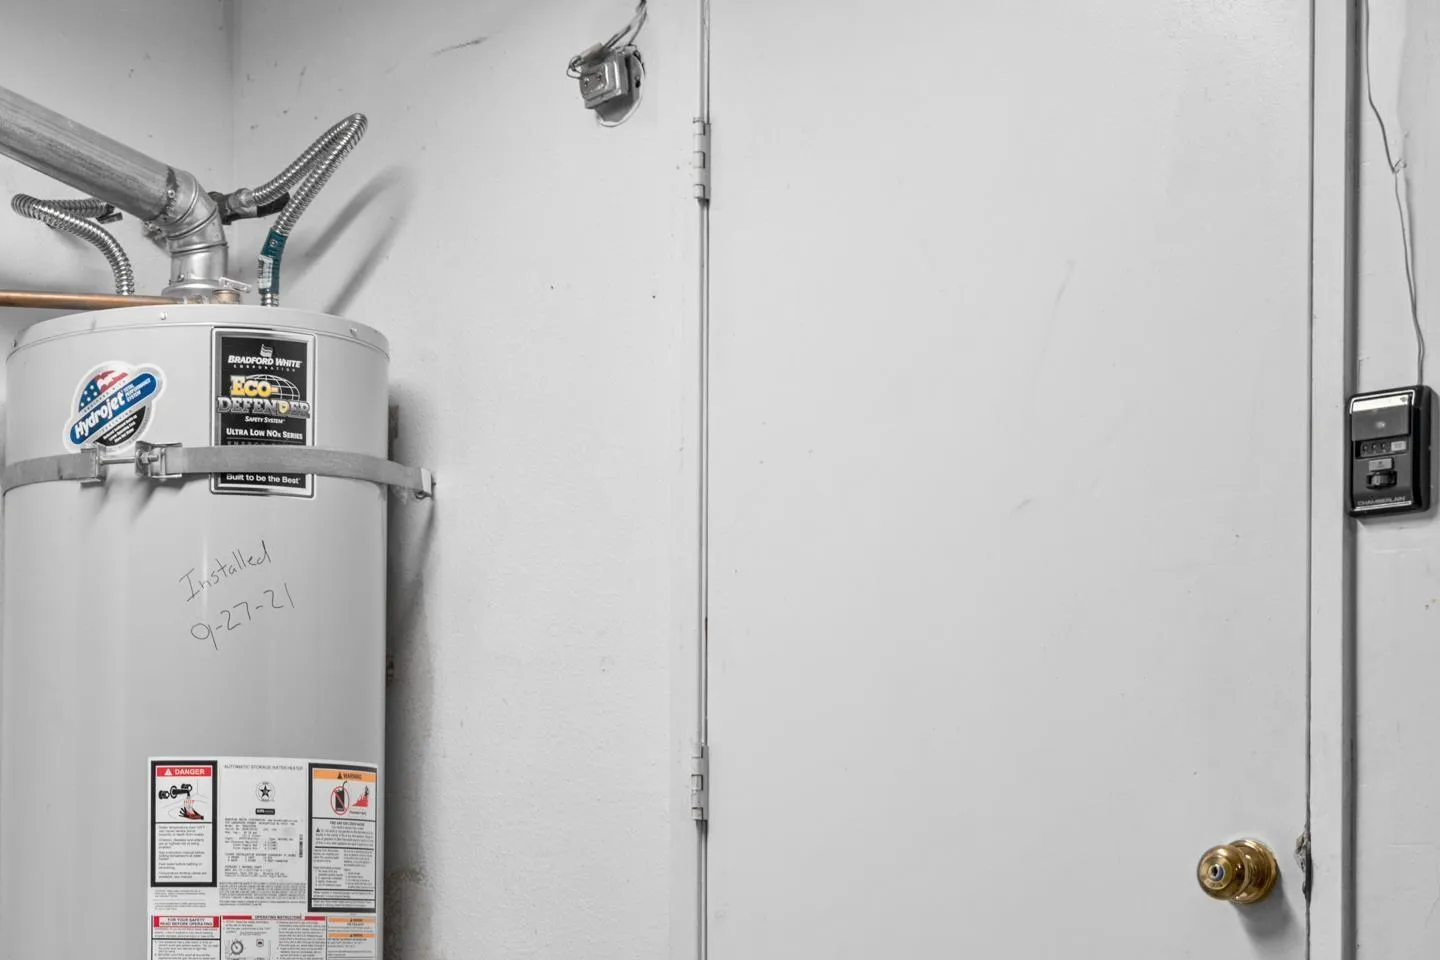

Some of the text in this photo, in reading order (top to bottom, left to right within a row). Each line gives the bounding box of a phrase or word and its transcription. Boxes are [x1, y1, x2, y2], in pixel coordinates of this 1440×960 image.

[227, 355, 303, 368] BRADFORD WHITE
[74, 390, 126, 439] Hydrojet
[217, 396, 311, 419] DEFENDER
[226, 428, 249, 436] ULTRA
[250, 429, 265, 437] LOW
[282, 431, 303, 440] SERIES
[226, 473, 245, 481] Built
[256, 474, 266, 482] be
[268, 475, 280, 483] the
[179, 539, 272, 602] Installed
[190, 583, 295, 651] 9-27-21
[174, 768, 205, 776] DANGER
